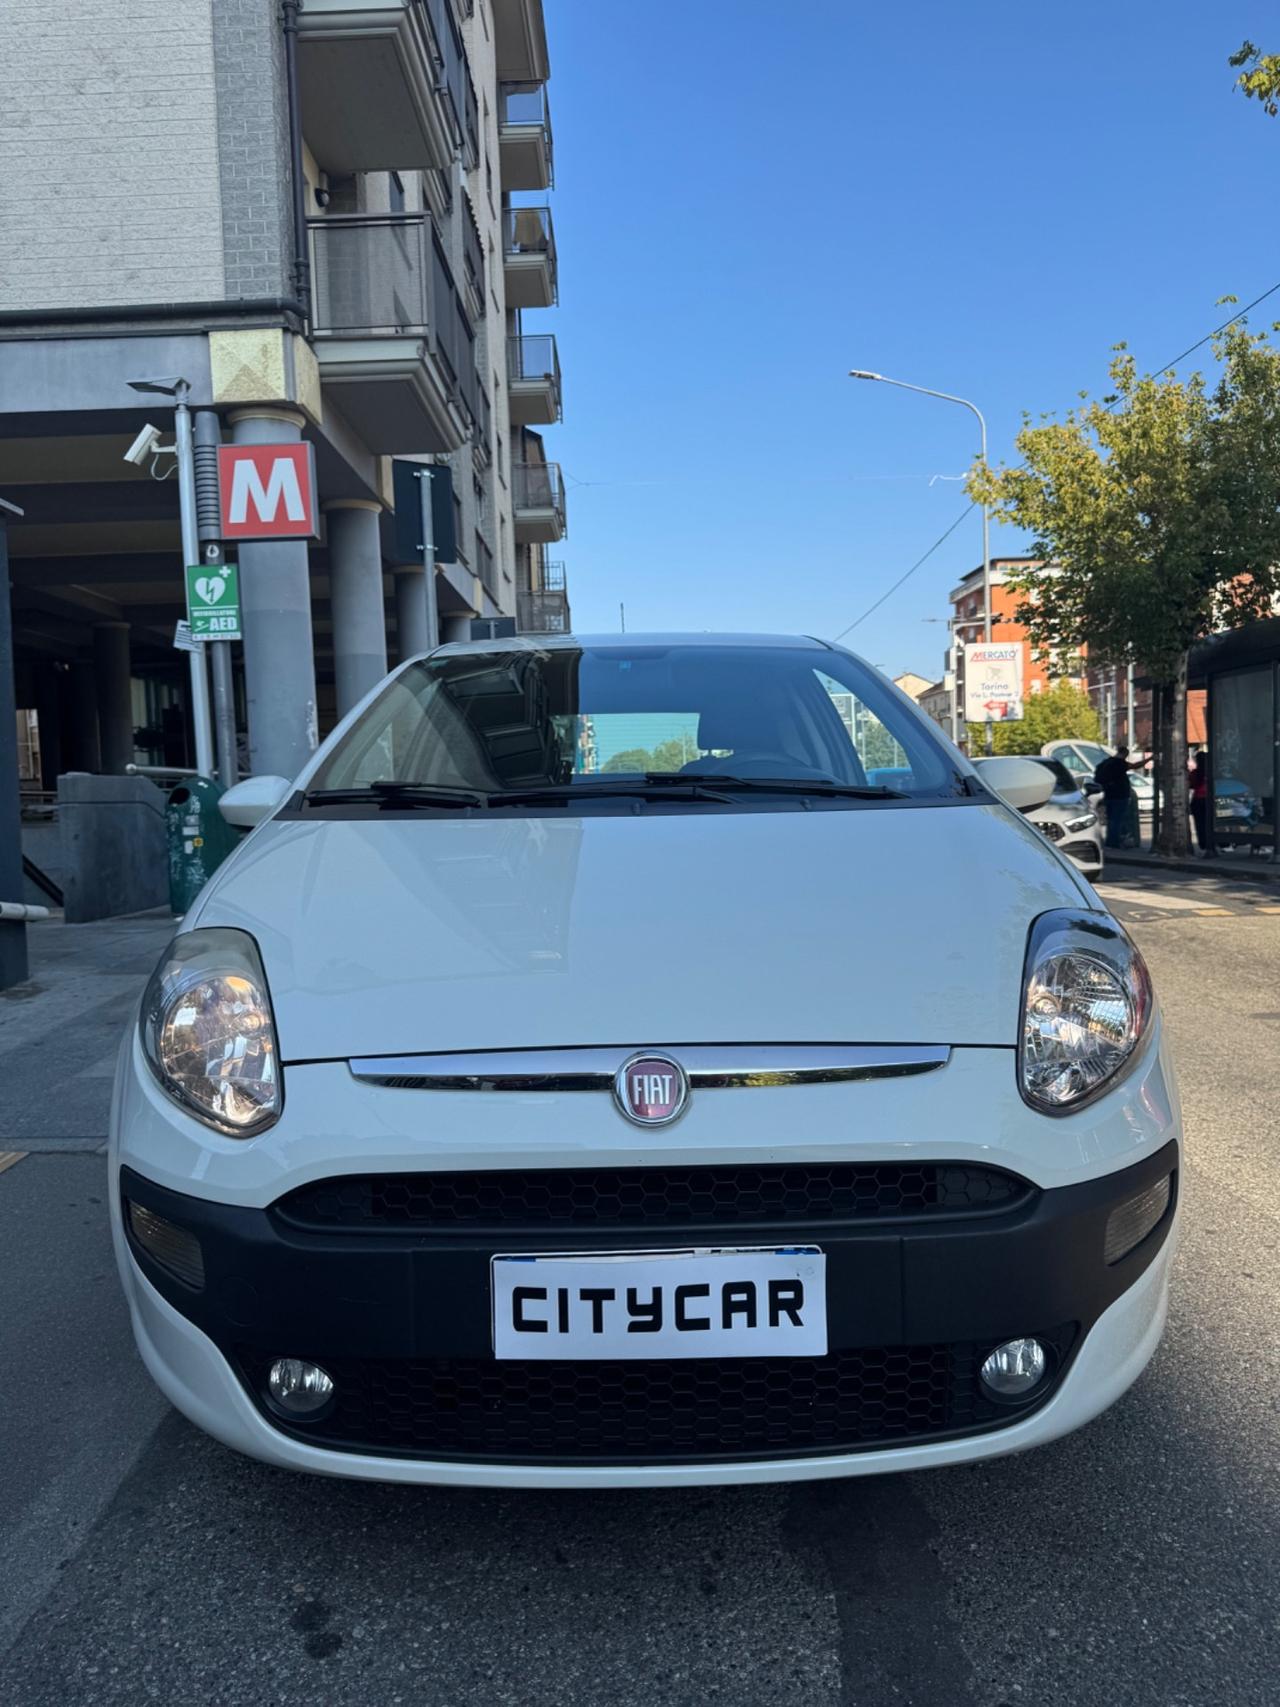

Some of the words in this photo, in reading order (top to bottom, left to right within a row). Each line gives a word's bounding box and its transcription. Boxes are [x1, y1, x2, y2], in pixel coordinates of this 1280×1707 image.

[228, 457, 307, 524] M
[209, 617, 238, 631] AED
[980, 682, 1009, 690] Torino
[632, 1074, 673, 1105] FIAT
[512, 1279, 804, 1334] CITYCAR
